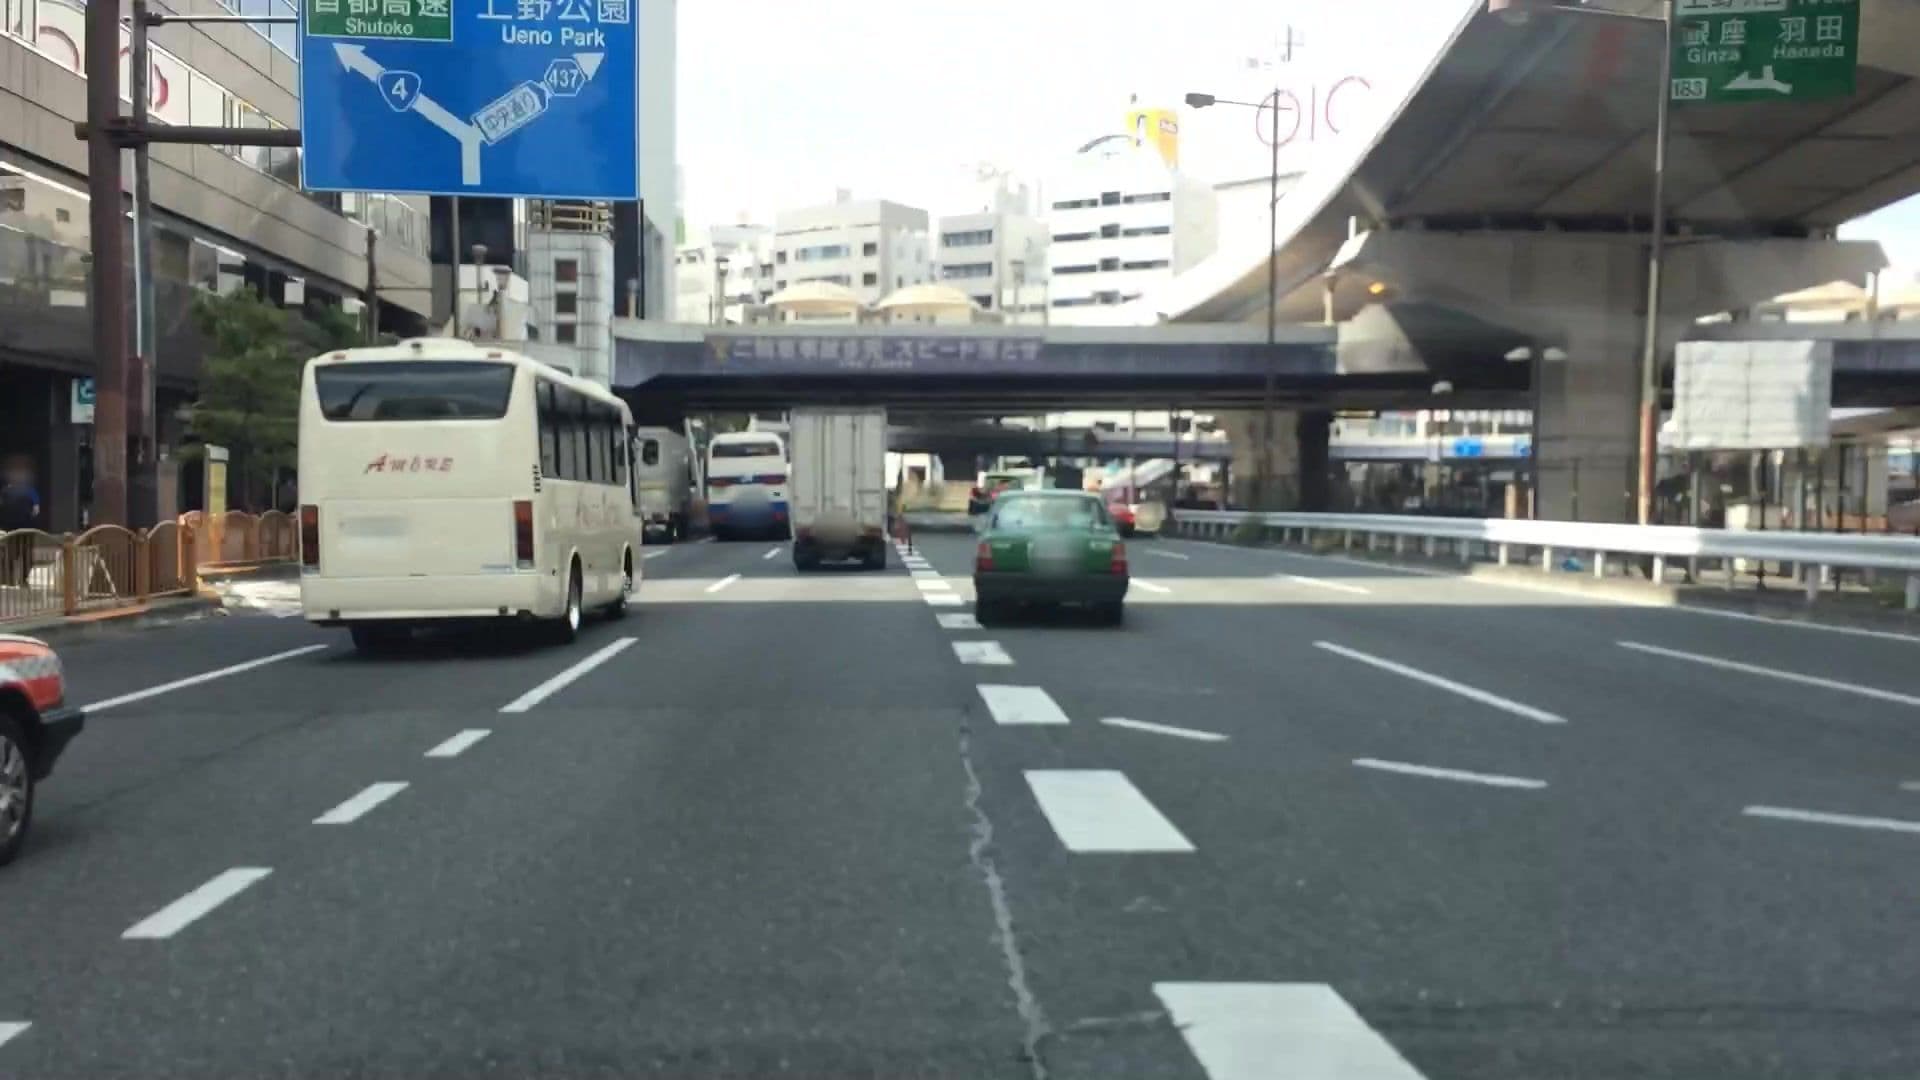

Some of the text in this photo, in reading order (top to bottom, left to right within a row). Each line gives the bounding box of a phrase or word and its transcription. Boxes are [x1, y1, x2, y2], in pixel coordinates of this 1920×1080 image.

[345, 17, 414, 35] Shutoko
[502, 24, 606, 48] Ueno Park
[1687, 48, 1741, 64] Ginza
[391, 77, 408, 101] 4
[549, 69, 579, 89] 437
